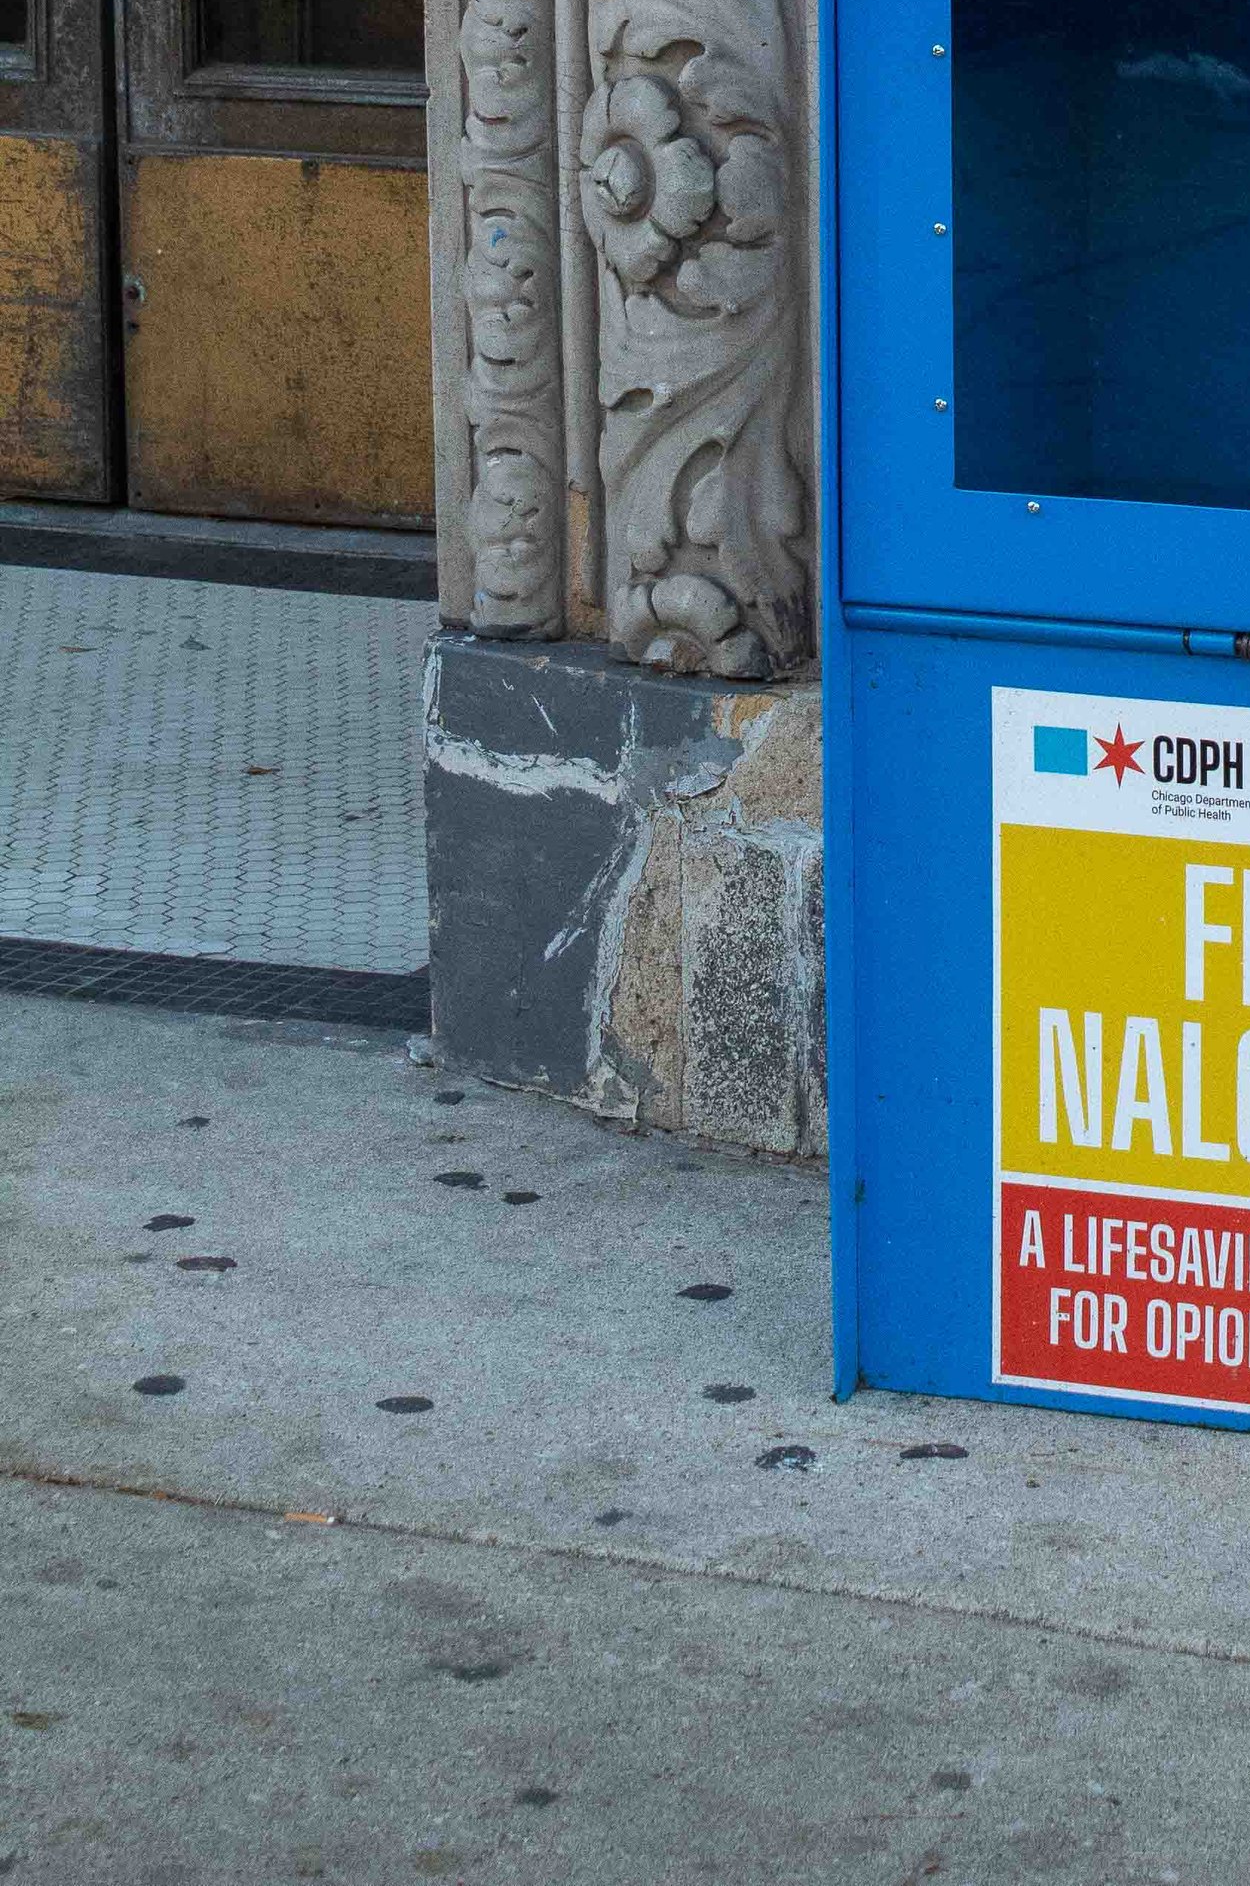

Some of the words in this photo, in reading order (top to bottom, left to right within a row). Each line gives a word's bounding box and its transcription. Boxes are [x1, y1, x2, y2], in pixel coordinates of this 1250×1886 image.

[1153, 735, 1243, 789] CDPH
[1151, 789, 1192, 805] Chicago
[1151, 803, 1162, 814] of
[1164, 804, 1195, 817] Public
[1198, 808, 1230, 820] Health
[1019, 1209, 1045, 1268] A
[1049, 1287, 1127, 1353] FOR
